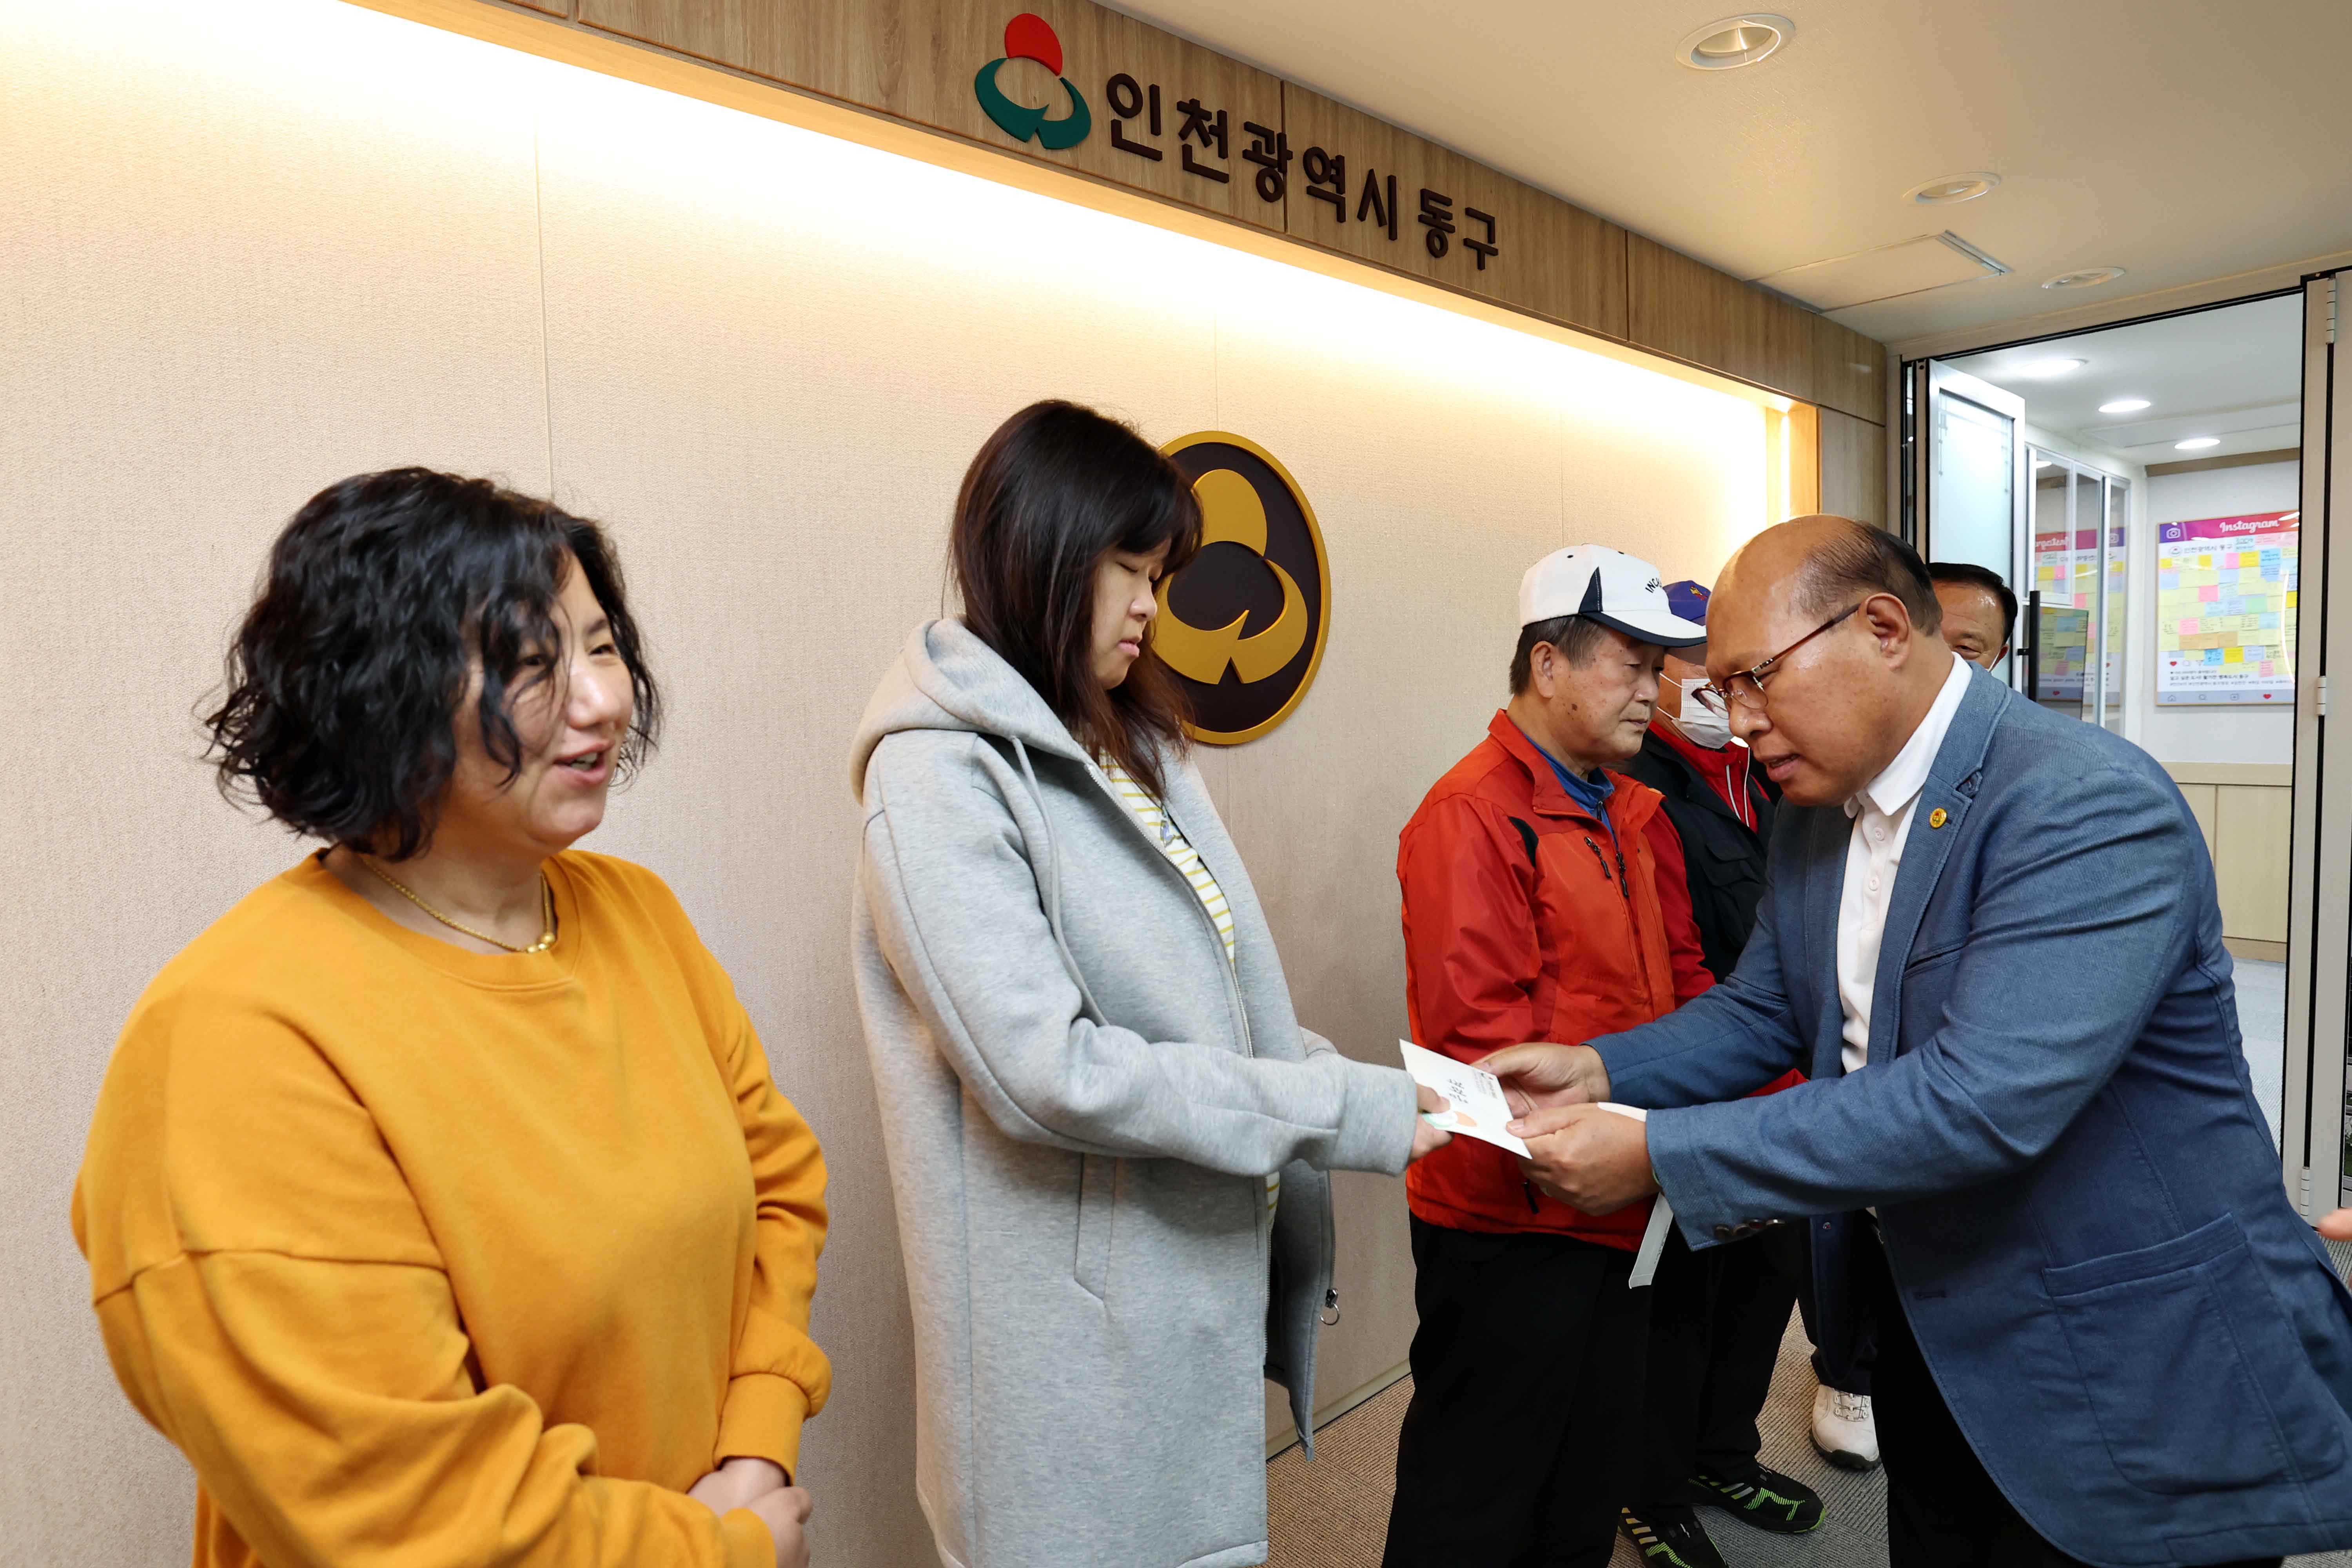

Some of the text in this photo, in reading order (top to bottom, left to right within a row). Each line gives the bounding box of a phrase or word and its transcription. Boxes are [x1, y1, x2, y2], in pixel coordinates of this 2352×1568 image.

[1106, 73, 1499, 270] 인천광역시 동구
[2219, 520, 2279, 534] Instagram
